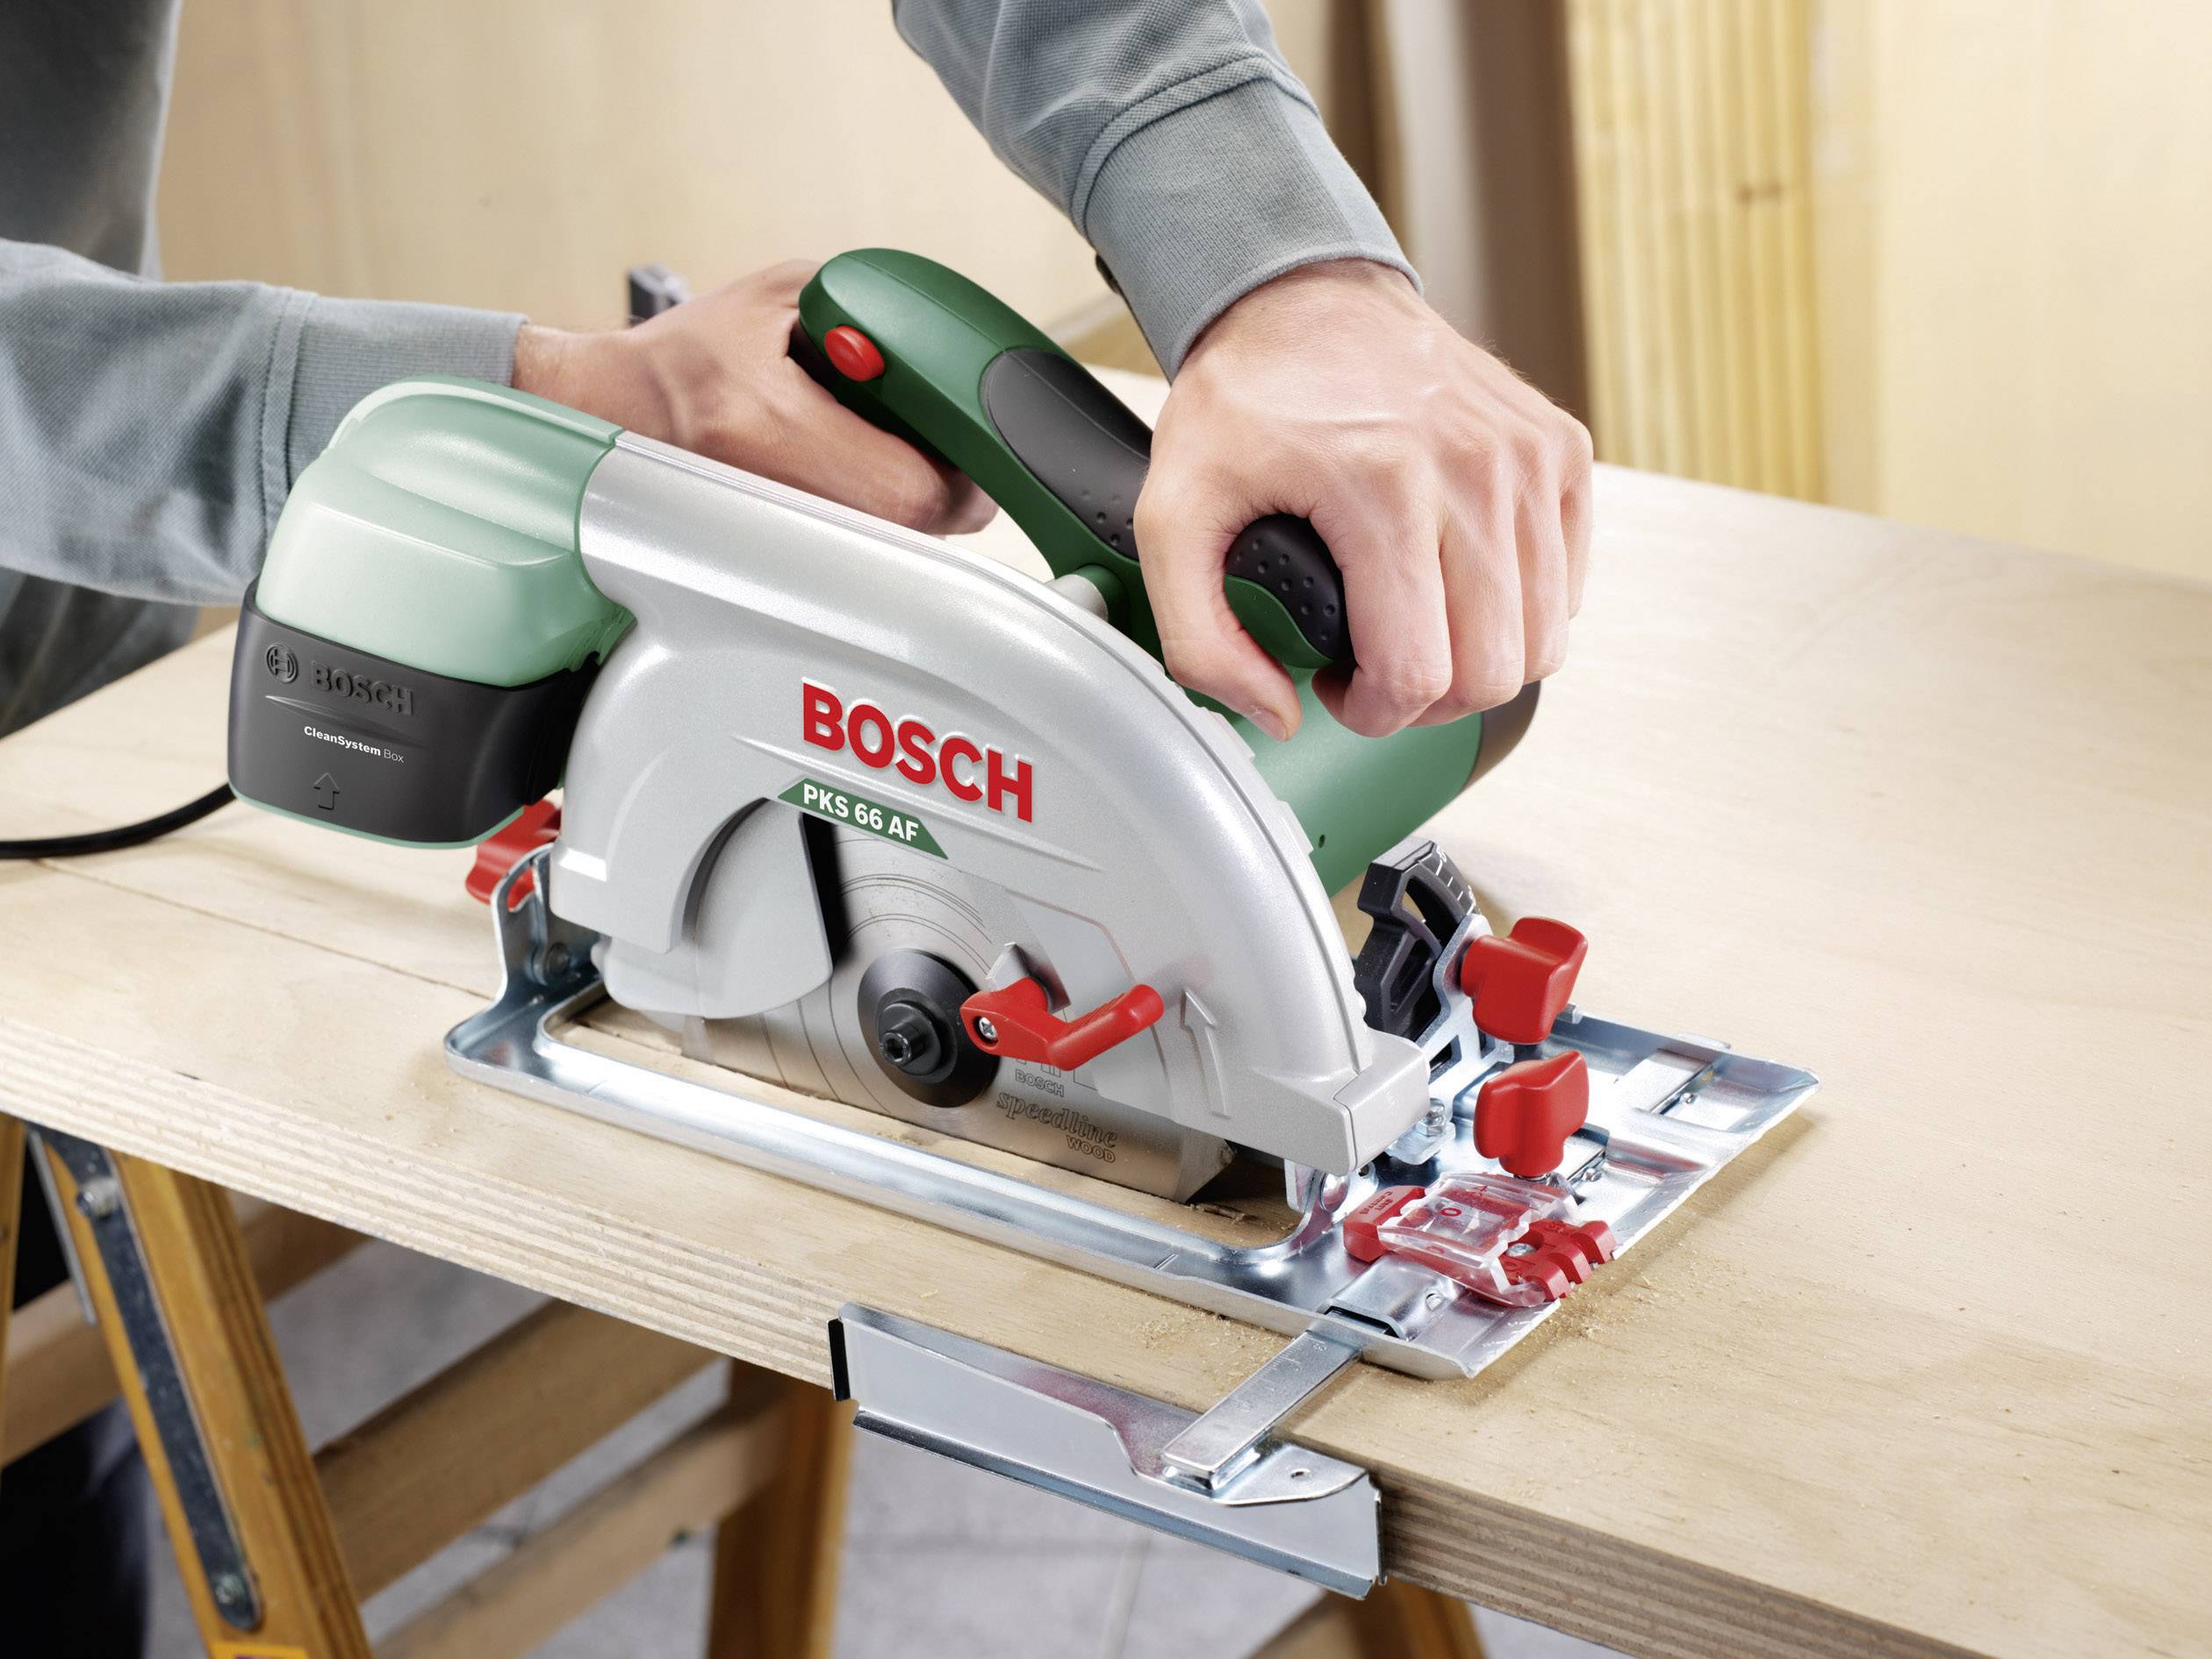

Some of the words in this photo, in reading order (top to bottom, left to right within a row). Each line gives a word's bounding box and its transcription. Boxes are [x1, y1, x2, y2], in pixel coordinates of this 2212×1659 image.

[311, 660, 415, 716] BOSCH
[304, 725, 381, 757] CleanSystem
[384, 748, 405, 764] Box
[803, 681, 1033, 823] BOSCH
[803, 782, 850, 818] PKS
[854, 803, 884, 831] 66
[887, 815, 919, 843] AF
[1015, 1068, 1065, 1098] BOSCH
[996, 1091, 1118, 1148] speedline
[1066, 1135, 1116, 1163] WOOD
